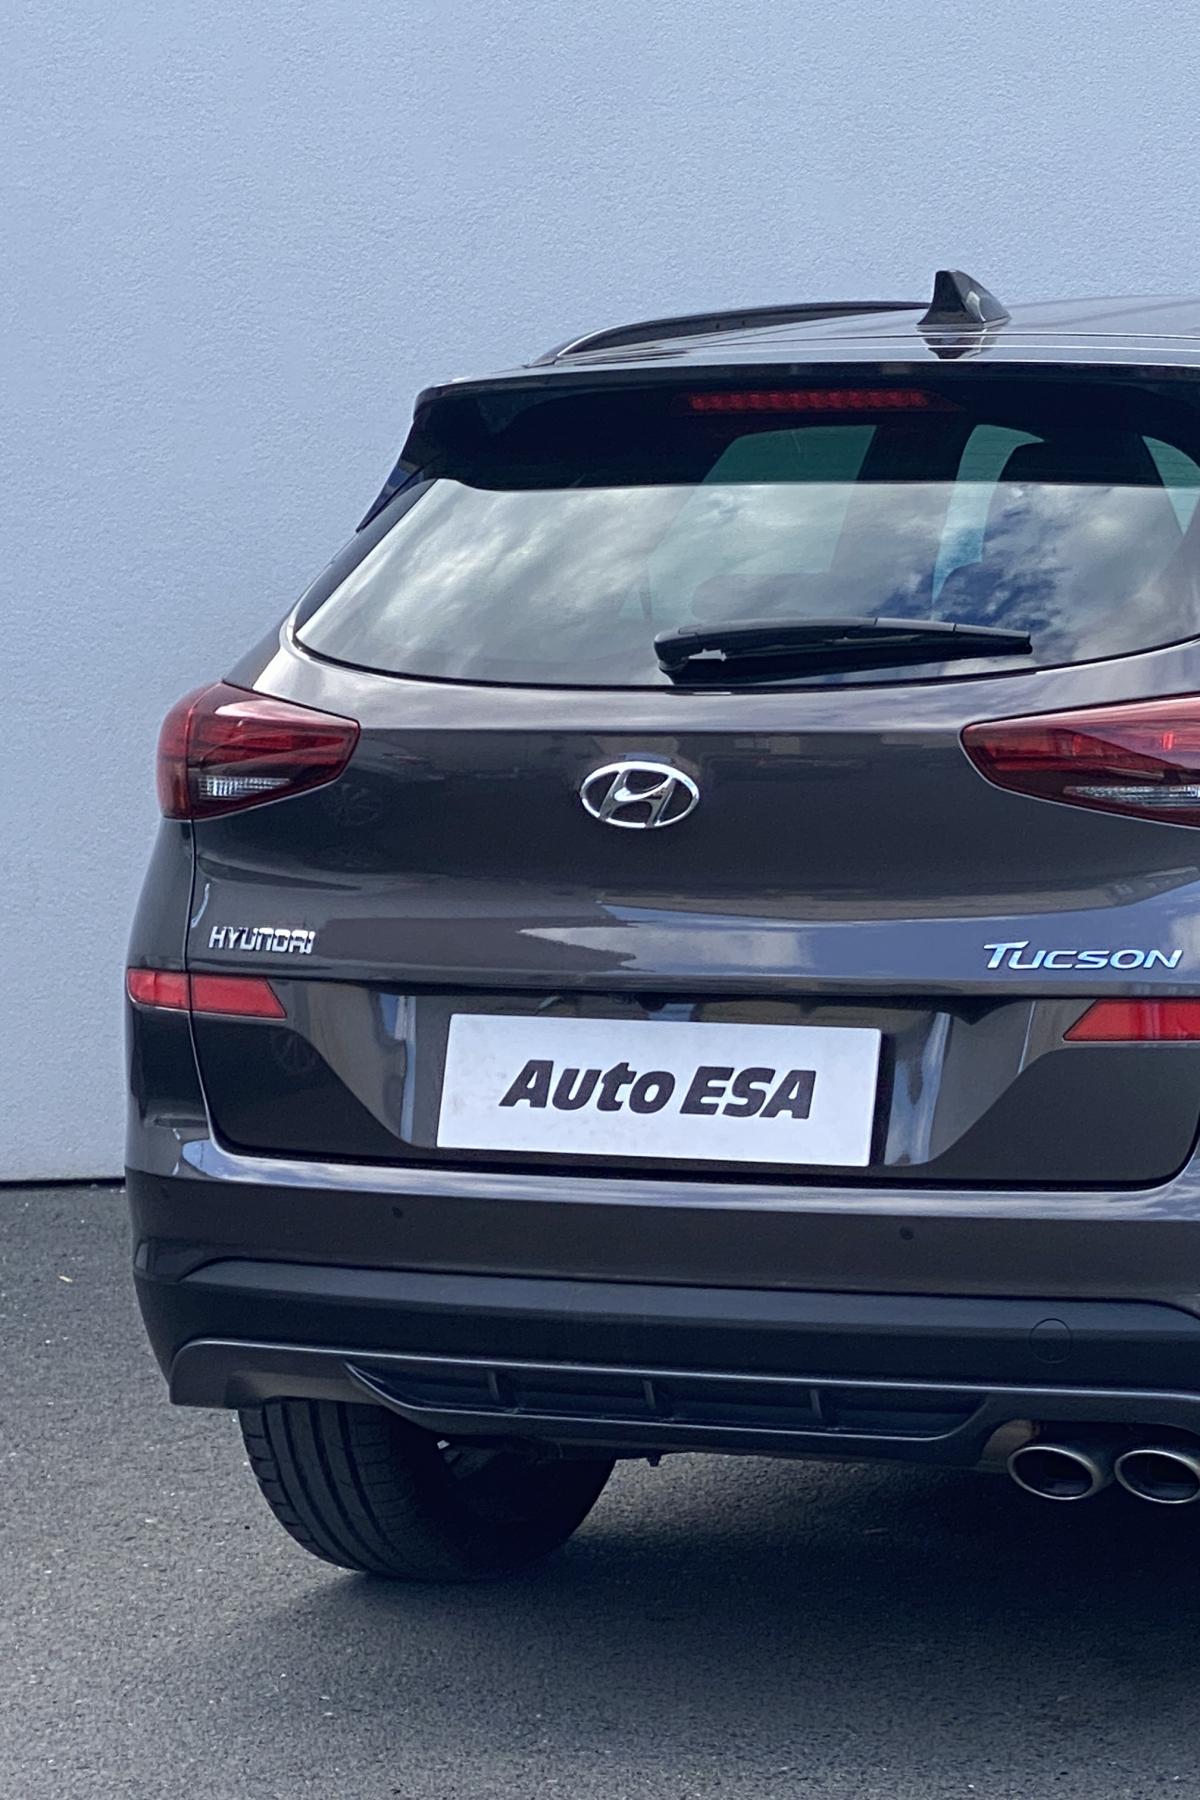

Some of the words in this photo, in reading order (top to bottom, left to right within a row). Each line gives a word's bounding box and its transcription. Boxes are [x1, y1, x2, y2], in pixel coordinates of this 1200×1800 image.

[208, 926, 316, 954] HYUNDAI
[983, 940, 1183, 969] TUCSON
[499, 1059, 676, 1114] Auto
[679, 1066, 817, 1120] ESA
